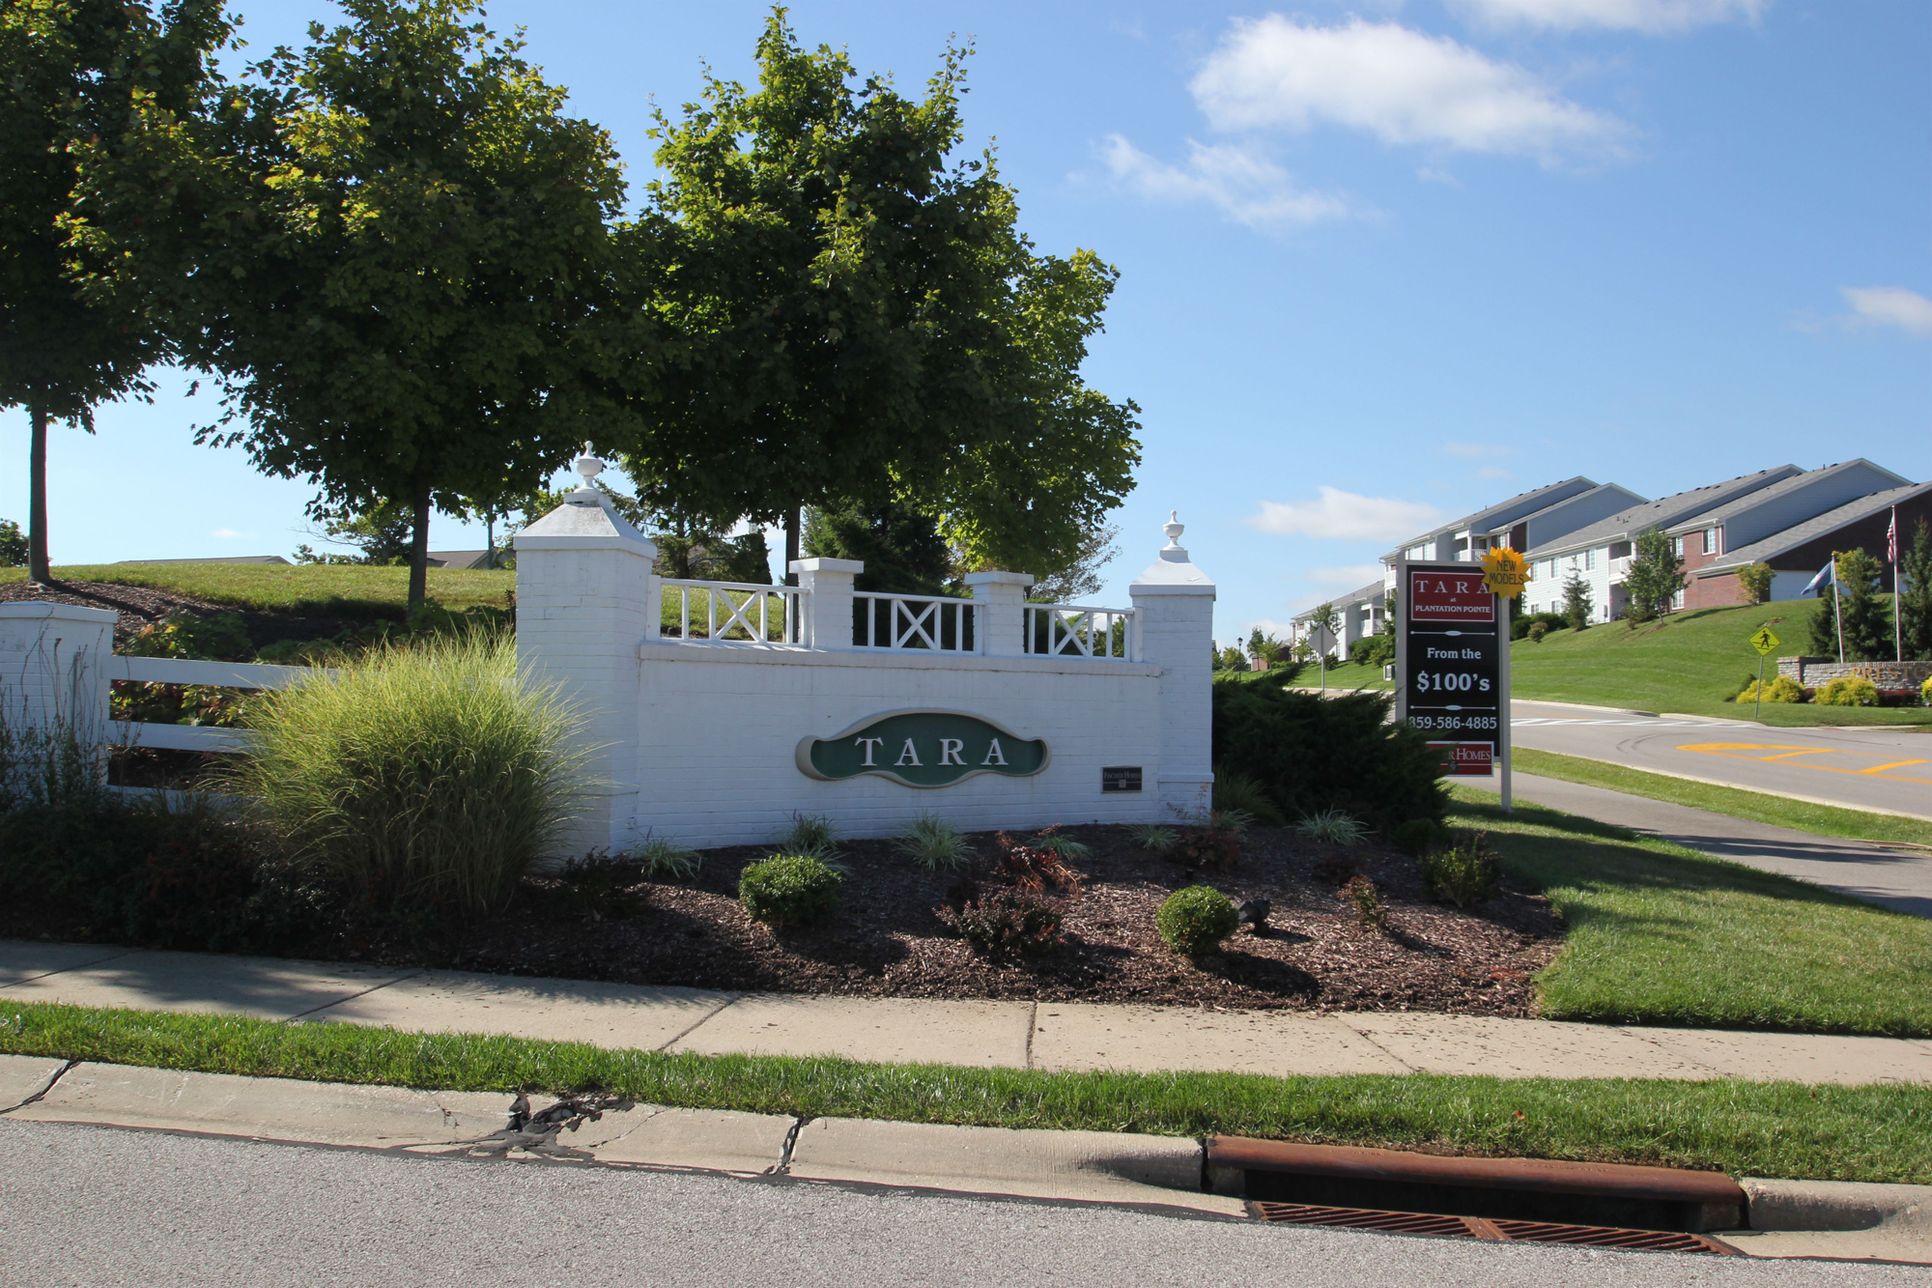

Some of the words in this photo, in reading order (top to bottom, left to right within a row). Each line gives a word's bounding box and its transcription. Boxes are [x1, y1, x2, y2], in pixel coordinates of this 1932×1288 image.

[1496, 560, 1516, 571] NEW
[1489, 573, 1524, 585] MODELS
[1415, 580, 1489, 594] TARA
[1415, 605, 1462, 613] PLANTATION
[1463, 606, 1491, 614] POINTE
[1427, 647, 1458, 659] From
[1461, 648, 1482, 659] the
[1416, 670, 1491, 693] $100's
[1408, 716, 1497, 729] 859-586-4885
[854, 737, 1009, 767] TARA
